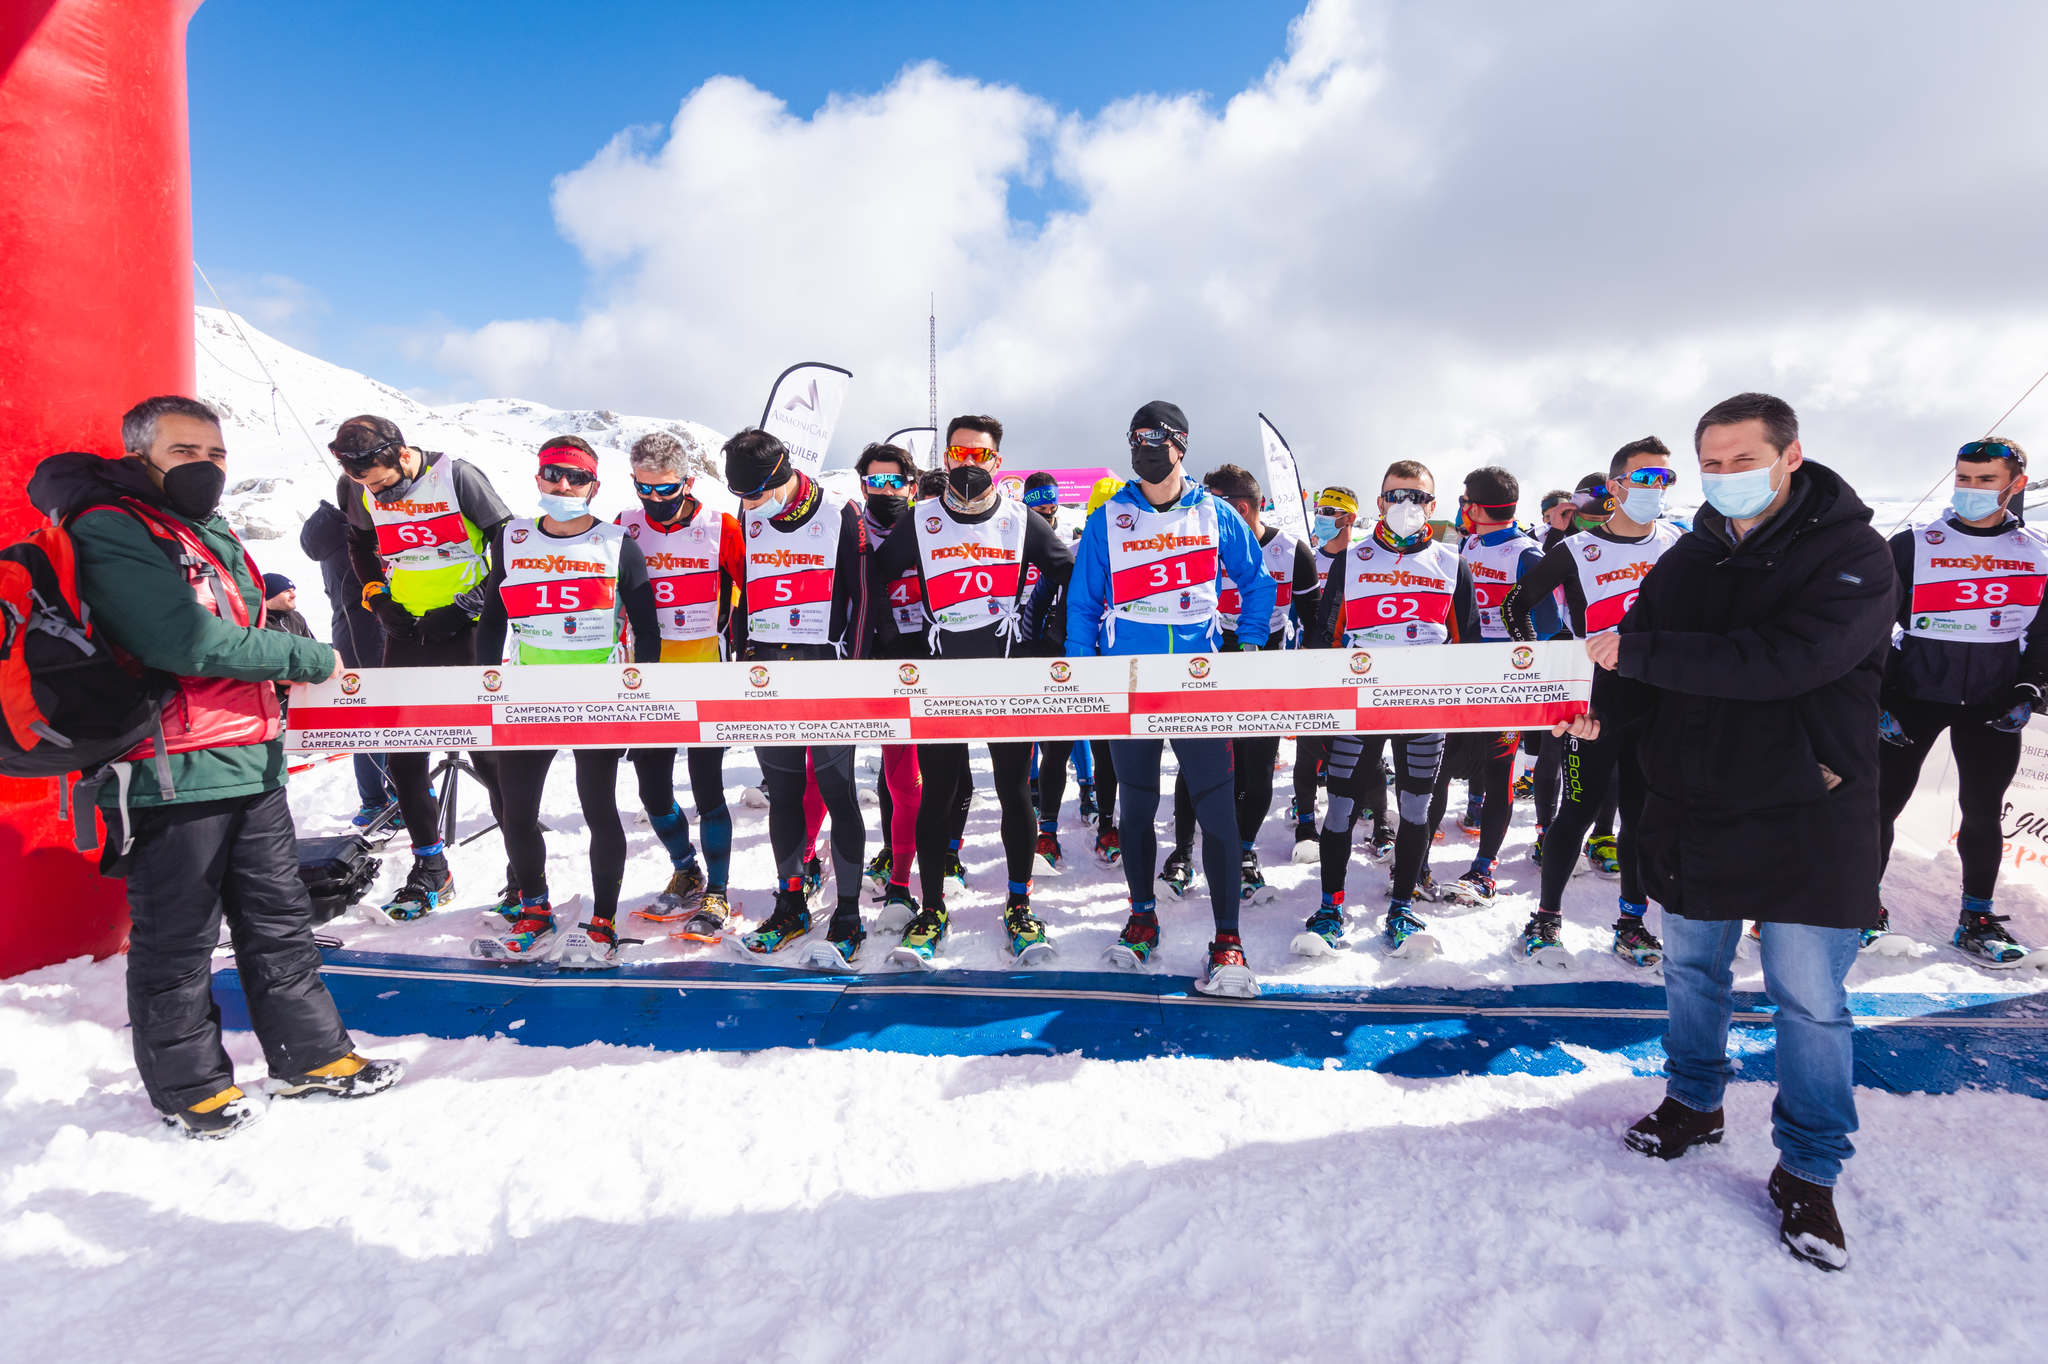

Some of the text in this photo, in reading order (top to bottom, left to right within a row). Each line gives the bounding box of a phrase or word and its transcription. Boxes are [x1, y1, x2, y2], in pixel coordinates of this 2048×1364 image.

[398, 525, 437, 545] 63
[1122, 532, 1211, 552] PICOSXTREME
[750, 549, 825, 568] PICOSXTREME
[931, 543, 1015, 561] PICOSXTREME
[511, 555, 606, 574] PICOSXTREME
[1931, 554, 2036, 572] PICOSXTREME
[1026, 566, 1038, 581] 6
[1149, 561, 1191, 587] 31
[1358, 570, 1446, 590] PICOSXTREME
[954, 571, 993, 594] 70
[536, 585, 580, 609] 15
[655, 581, 675, 603] 8
[774, 580, 792, 602] 5
[890, 583, 910, 603] 4
[1955, 582, 2009, 604] 38
[1377, 596, 1420, 620] 62
[1342, 677, 1379, 685] FCDME
[1503, 672, 1541, 680] FCDME
[1181, 681, 1218, 689] FCDME
[1373, 684, 1565, 697] CAMPEONATO Y COPA CANTABRIA
[477, 694, 510, 702] FCDME
[617, 692, 650, 700] FCDME
[745, 690, 778, 698] FCDME
[1373, 698, 1435, 706] CARRERAS
[1466, 694, 1521, 704] MONTAÑA
[1525, 692, 1570, 702] FCDME
[333, 697, 367, 705] FCDME
[924, 698, 997, 707] CAMPEONATO
[1009, 697, 1040, 706] COPA
[1043, 696, 1105, 705] CANTABRIA
[505, 705, 575, 714] CAMPEONATO
[585, 704, 614, 713] COPA
[617, 703, 675, 712] CANTABRIA
[924, 707, 983, 716] CARRERAS
[1012, 704, 1064, 714] MONTAÑA
[1066, 704, 1110, 713] FCDME
[505, 715, 560, 723] CARRERAS
[588, 713, 637, 722] MONTAÑA
[640, 712, 681, 721] FCDME
[1148, 715, 1224, 724] CAMPEONATO
[1236, 713, 1267, 722] COPA
[1270, 712, 1335, 721] CANTABRIA
[716, 723, 788, 732] CAMPEONATO
[798, 722, 828, 731] COPA
[830, 721, 890, 730] CANTABRIA
[1148, 720, 1340, 733] CARRERAS POR MONTAÑA FCDME
[302, 730, 371, 739] CAMPEONATO
[383, 728, 411, 738] COPA
[414, 728, 473, 737] CANTABRIA
[716, 733, 773, 741] CARRERAS
[800, 730, 850, 739] MONTAÑA
[853, 730, 896, 739] FCDME
[301, 736, 478, 749] CARRERAS POR MONTAÑA FCDME
[1569, 754, 1584, 803] Body
